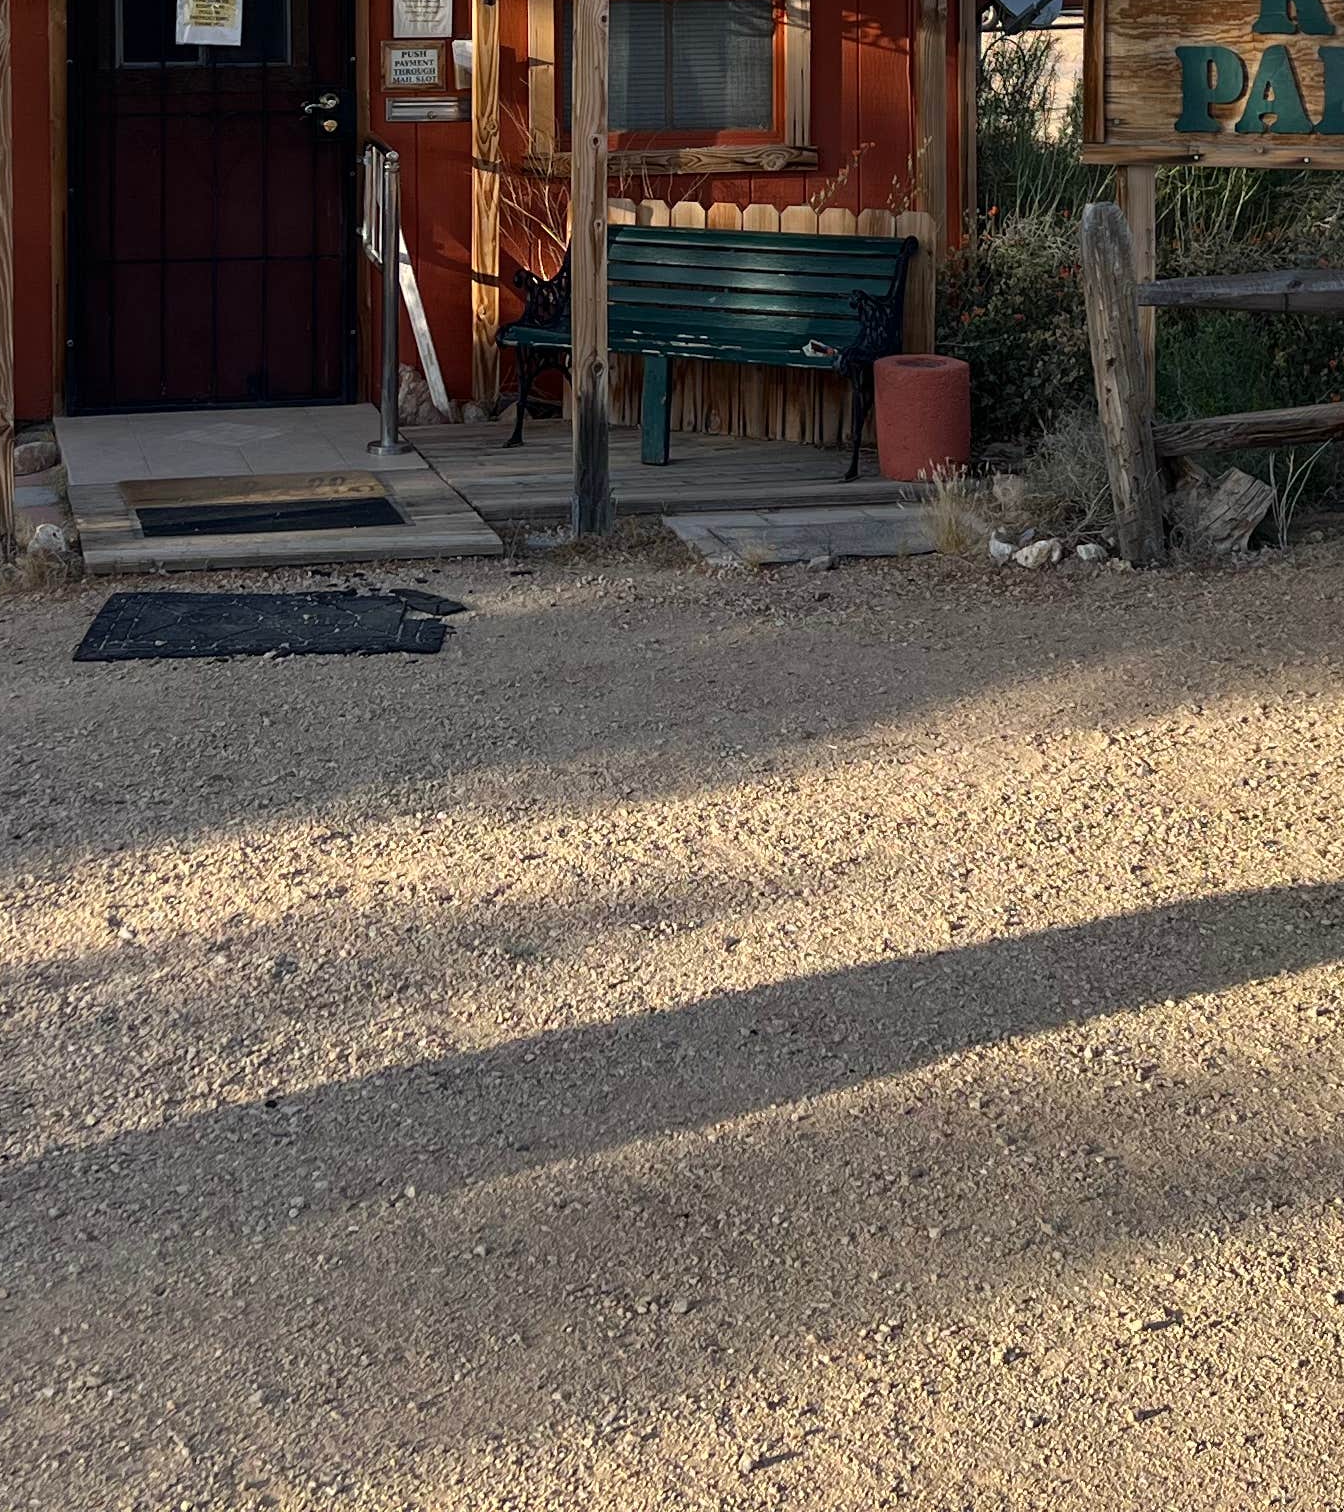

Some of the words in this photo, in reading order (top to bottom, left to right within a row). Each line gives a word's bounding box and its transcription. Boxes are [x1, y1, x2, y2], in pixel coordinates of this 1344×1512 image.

[401, 50, 427, 58] PUSH
[394, 59, 434, 67] PAYMENT
[393, 68, 436, 76] THROUGH
[392, 76, 412, 84] MAIL
